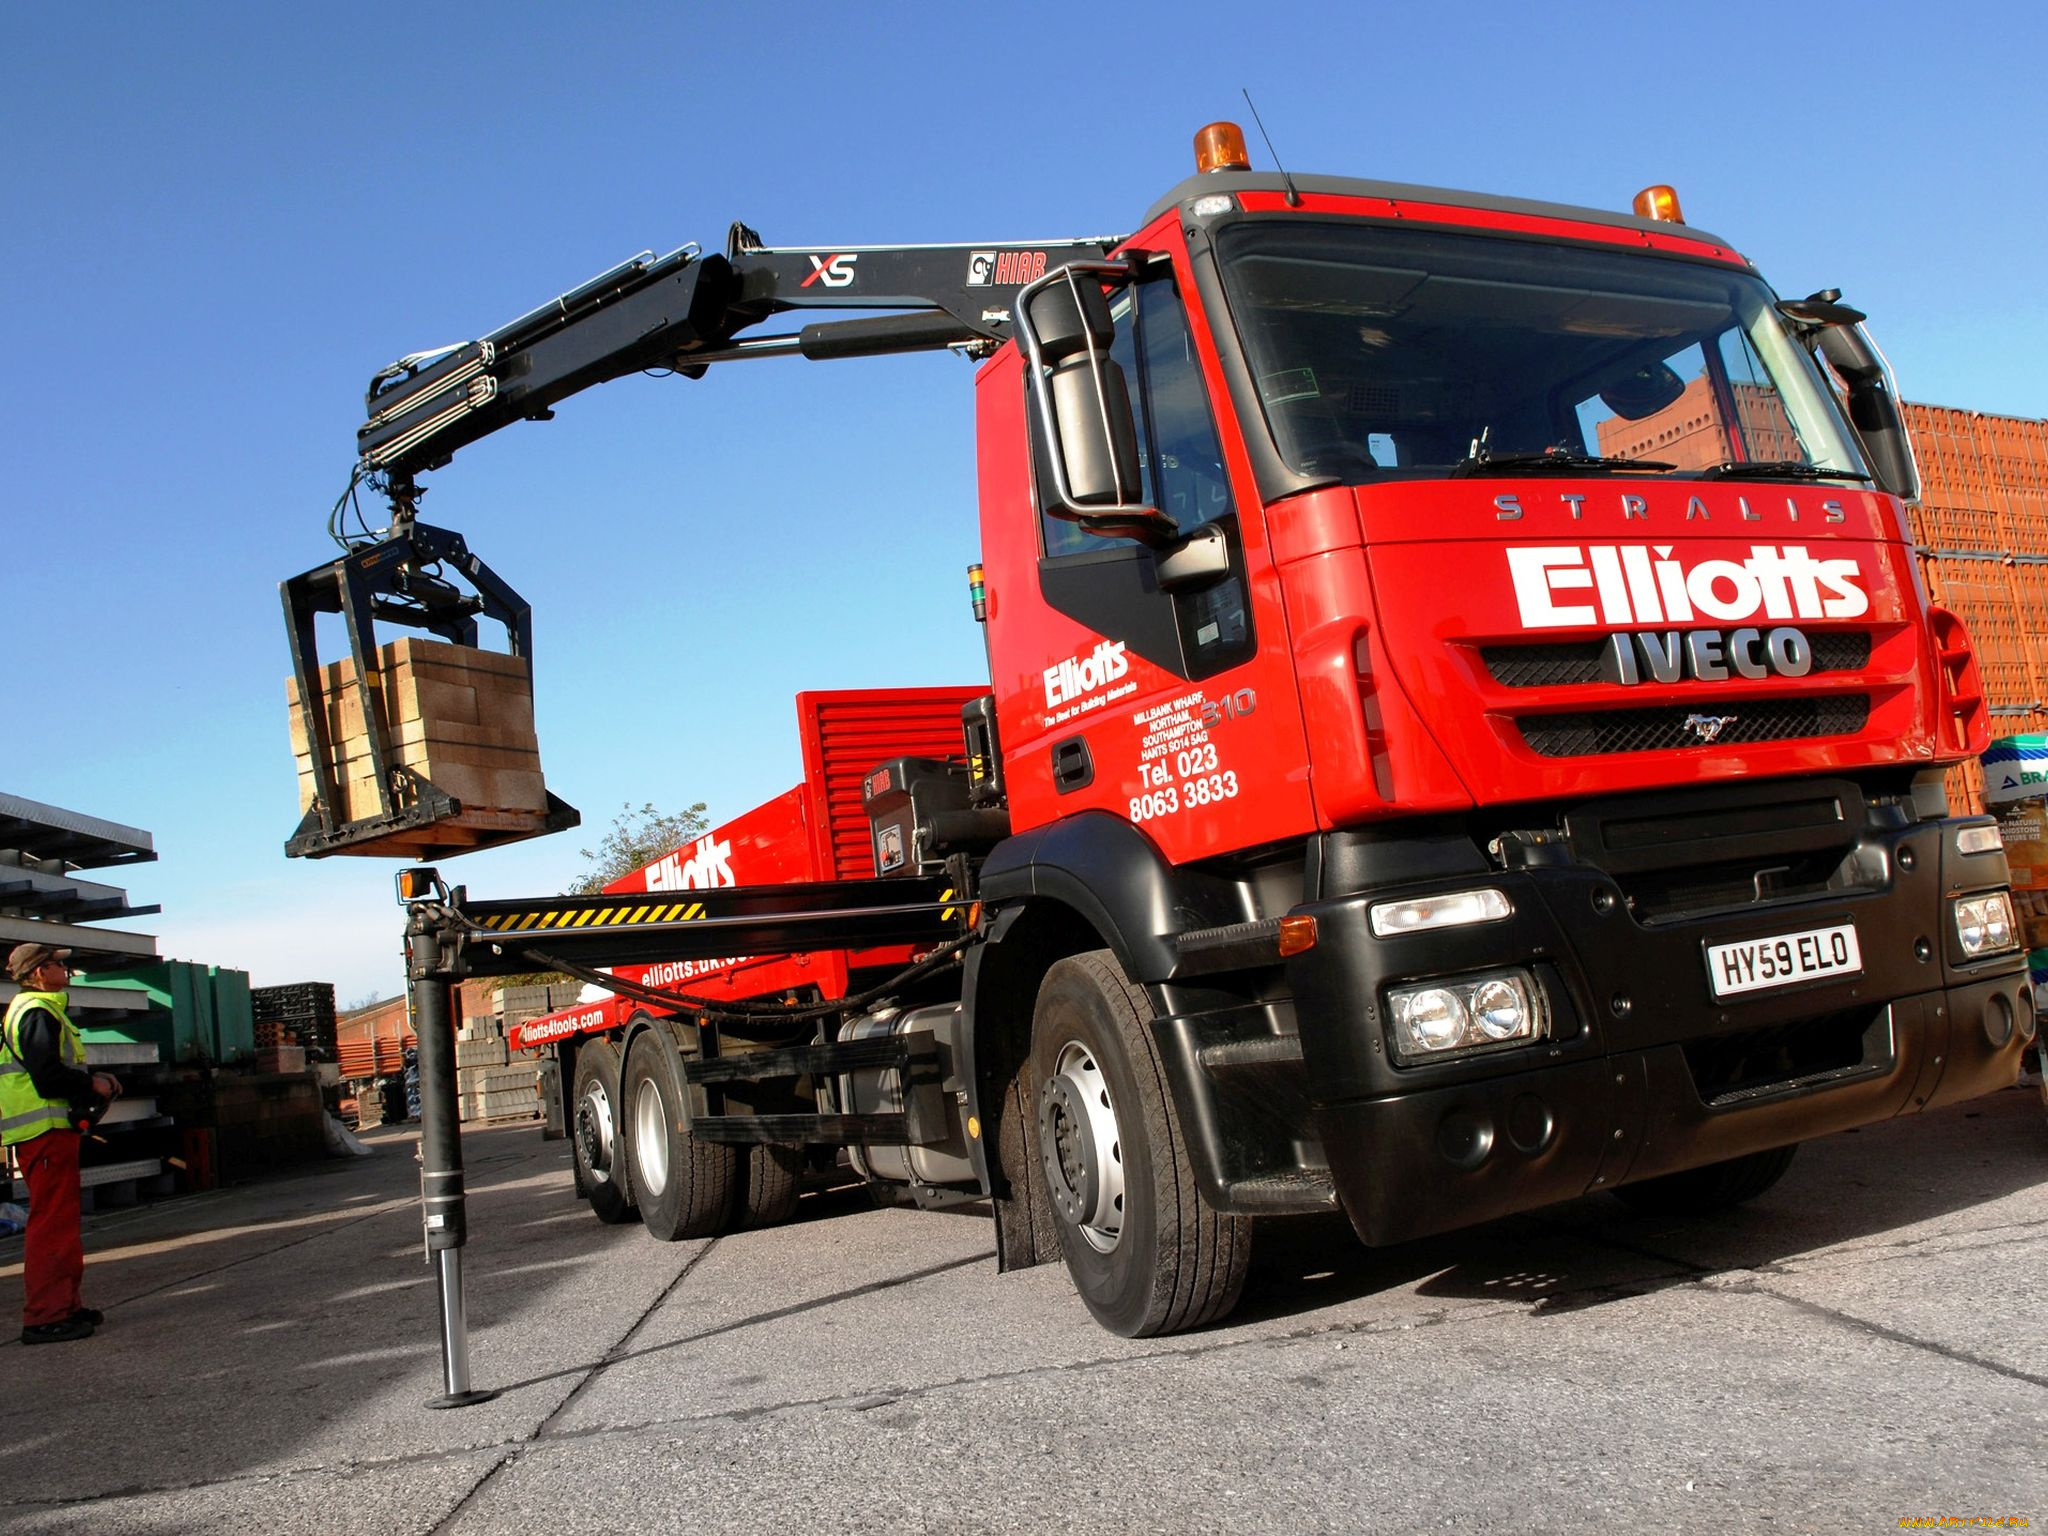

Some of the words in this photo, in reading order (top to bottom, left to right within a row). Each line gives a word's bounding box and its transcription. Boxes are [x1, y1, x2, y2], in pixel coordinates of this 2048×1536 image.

[800, 254, 857, 287] XS
[995, 252, 1047, 285] HIAB
[1493, 494, 1845, 523] STRALIS
[1505, 545, 1869, 628] Elliotts
[1043, 640, 1129, 709] Elliotts
[1610, 627, 1812, 686] IVECO
[1044, 715, 1056, 728] The
[1056, 708, 1071, 723] Best
[1071, 705, 1080, 717] for
[1081, 695, 1106, 713] Building
[1107, 681, 1138, 702] Materials
[1133, 702, 1173, 726] MILLBANK
[1201, 688, 1257, 729] 310
[1141, 744, 1168, 762] HANTS
[1168, 736, 1190, 753] SO14
[1190, 730, 1209, 746] 5AG
[1142, 718, 1204, 748] SOUTHAMPTON
[1137, 757, 1174, 789] Tel.
[1177, 743, 1219, 778] 023
[1129, 788, 1179, 823] 8063
[1184, 770, 1239, 809] 3833
[2000, 826, 2041, 835] ANDSTONE
[2008, 819, 2042, 828] NATURAL
[645, 834, 736, 892] Elliotts
[1721, 941, 1793, 986] HY59
[1797, 931, 1848, 973] ELO
[523, 1010, 604, 1042] lliotts4tools.com
